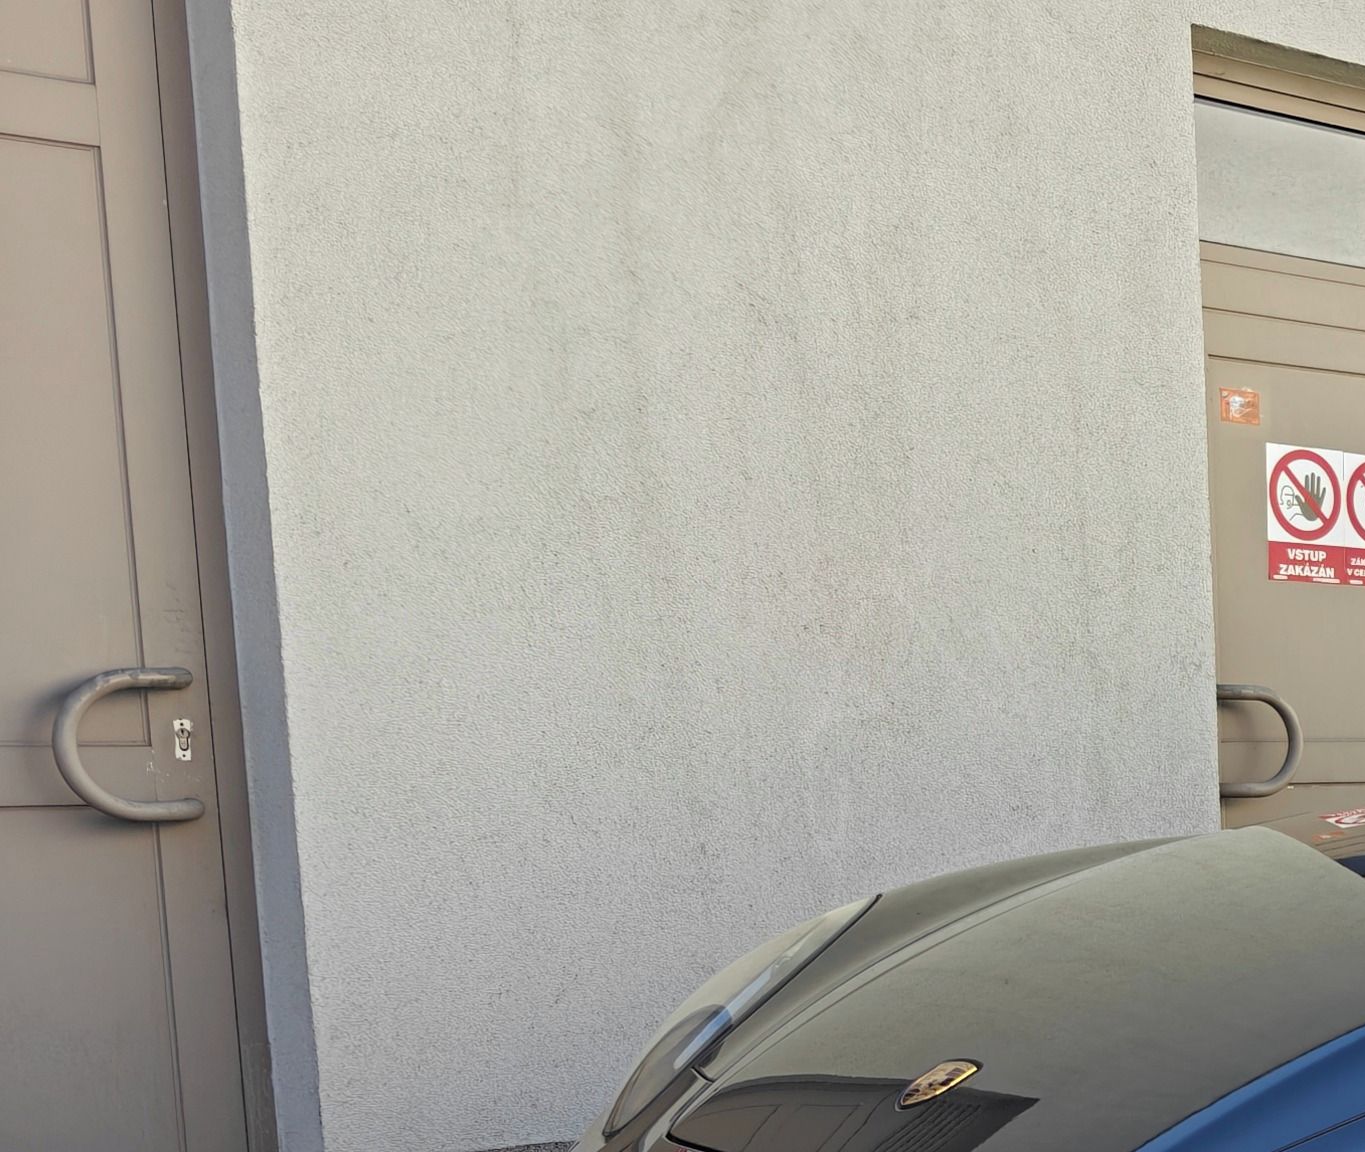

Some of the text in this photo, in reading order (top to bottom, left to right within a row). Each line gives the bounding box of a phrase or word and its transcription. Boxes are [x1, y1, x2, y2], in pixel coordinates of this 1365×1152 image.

[1287, 548, 1327, 562] VSTUP
[1279, 562, 1335, 578] ZAKÁZÁN
[1346, 568, 1353, 576] V
